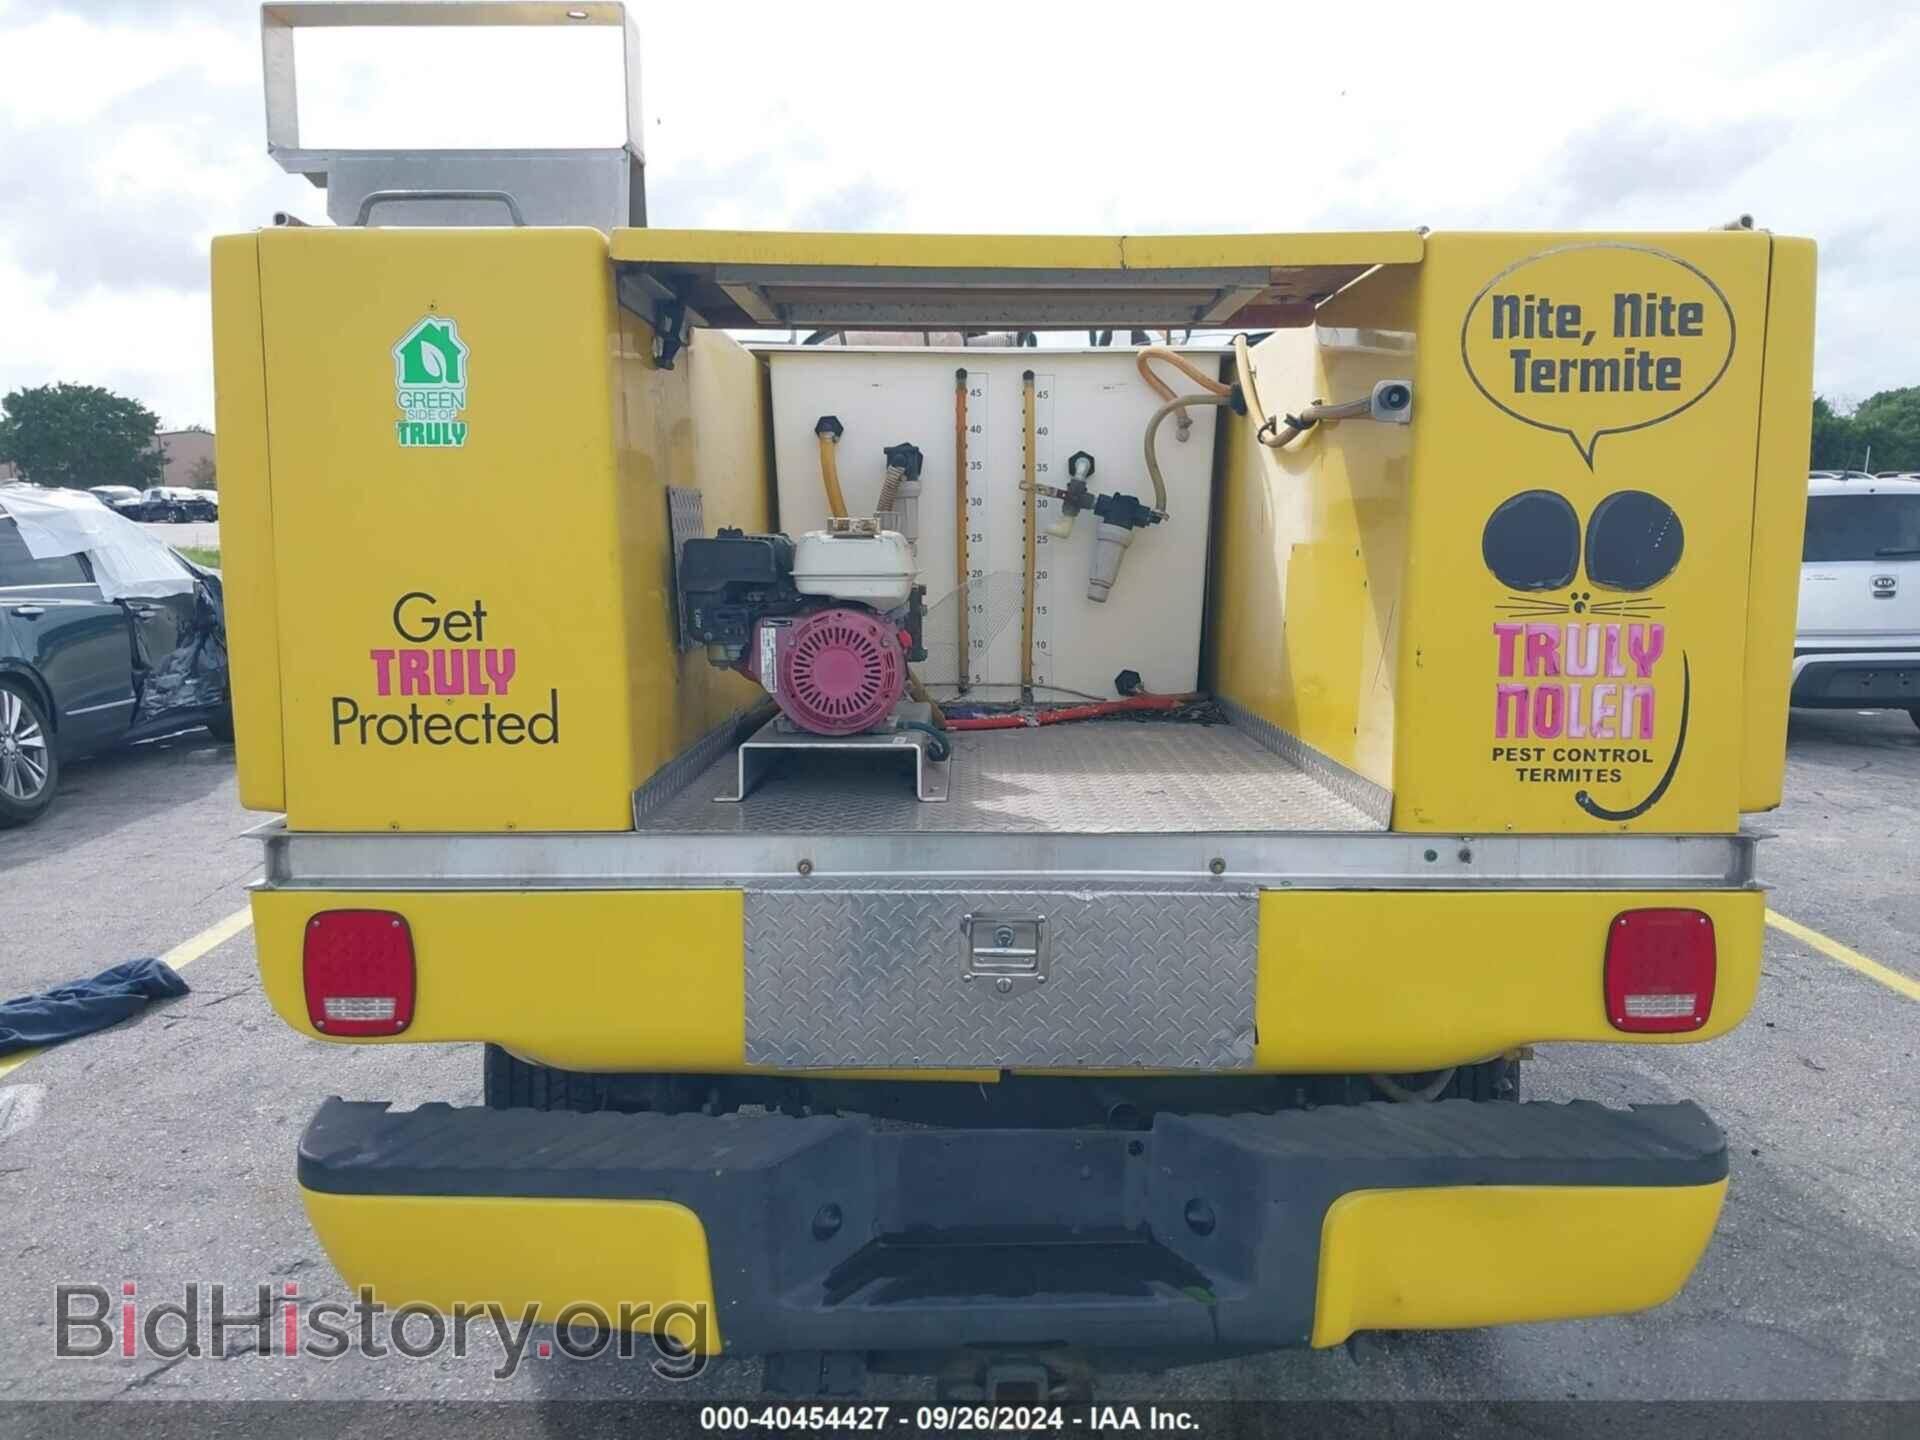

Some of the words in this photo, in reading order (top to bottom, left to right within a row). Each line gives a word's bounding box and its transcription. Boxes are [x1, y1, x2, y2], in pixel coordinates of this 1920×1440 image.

[1492, 294, 1596, 346] Nite,
[1613, 292, 1703, 338] Nite
[1509, 347, 1682, 393] Termite
[970, 388, 983, 397] 45
[1037, 390, 1049, 399] 45
[398, 391, 464, 409] GREEN
[407, 409, 436, 421] SIDE
[439, 409, 456, 421] OF
[398, 422, 466, 445] TRULY
[970, 425, 982, 434] 40
[1037, 426, 1049, 436] 40
[970, 461, 983, 470] 35
[1037, 463, 1049, 473] 35
[971, 497, 983, 506] 30
[1037, 499, 1048, 508] 30
[971, 534, 983, 543] 25
[1036, 535, 1048, 544] 25
[972, 569, 983, 578] 20
[1036, 571, 1048, 580] 20
[972, 605, 984, 614] 15
[1036, 606, 1048, 615] 15
[393, 591, 488, 643] Get
[973, 640, 984, 648] 10
[1036, 640, 1047, 649] 10
[1493, 622, 1666, 678] TRULY
[370, 648, 516, 696] TRULY
[975, 674, 982, 683] 5
[1038, 675, 1045, 684] 5
[1495, 683, 1656, 740] NOLEN
[332, 688, 559, 746] Protected
[1492, 747, 1546, 762] PEST
[1553, 747, 1654, 764] CONTROL
[1516, 768, 1622, 783] TERMITES
